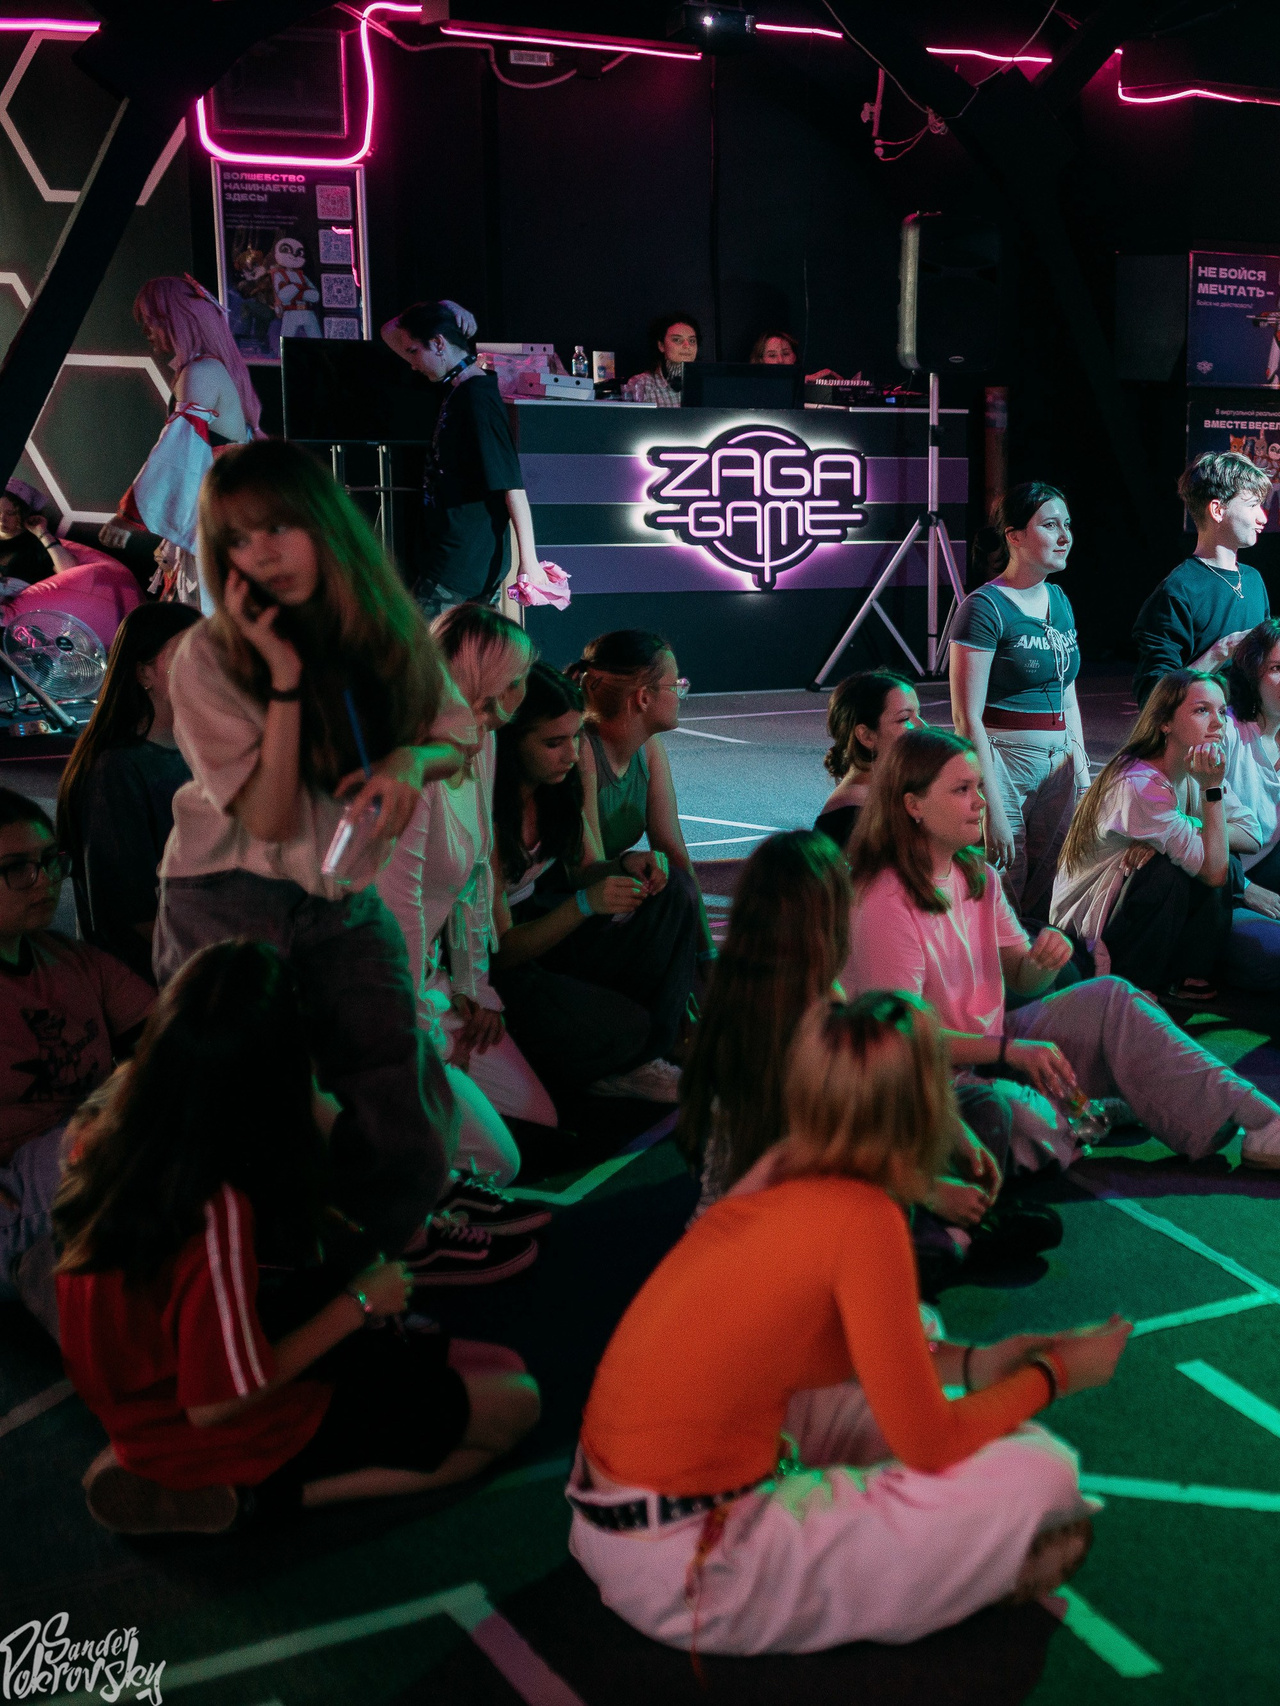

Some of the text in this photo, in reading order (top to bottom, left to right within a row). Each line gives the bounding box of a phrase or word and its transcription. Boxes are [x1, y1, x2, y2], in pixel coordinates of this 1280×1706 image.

[223, 172, 305, 182] ВОЛШЕБСТВО
[224, 182, 305, 193] НАЧИНАЕТСЯ
[1198, 265, 1267, 281] НЕ БОЙСЯ
[1197, 282, 1265, 298] МЕЧТАТЬ
[1203, 419, 1247, 429] ВМЕСТЕ
[659, 447, 862, 498] ZAGA
